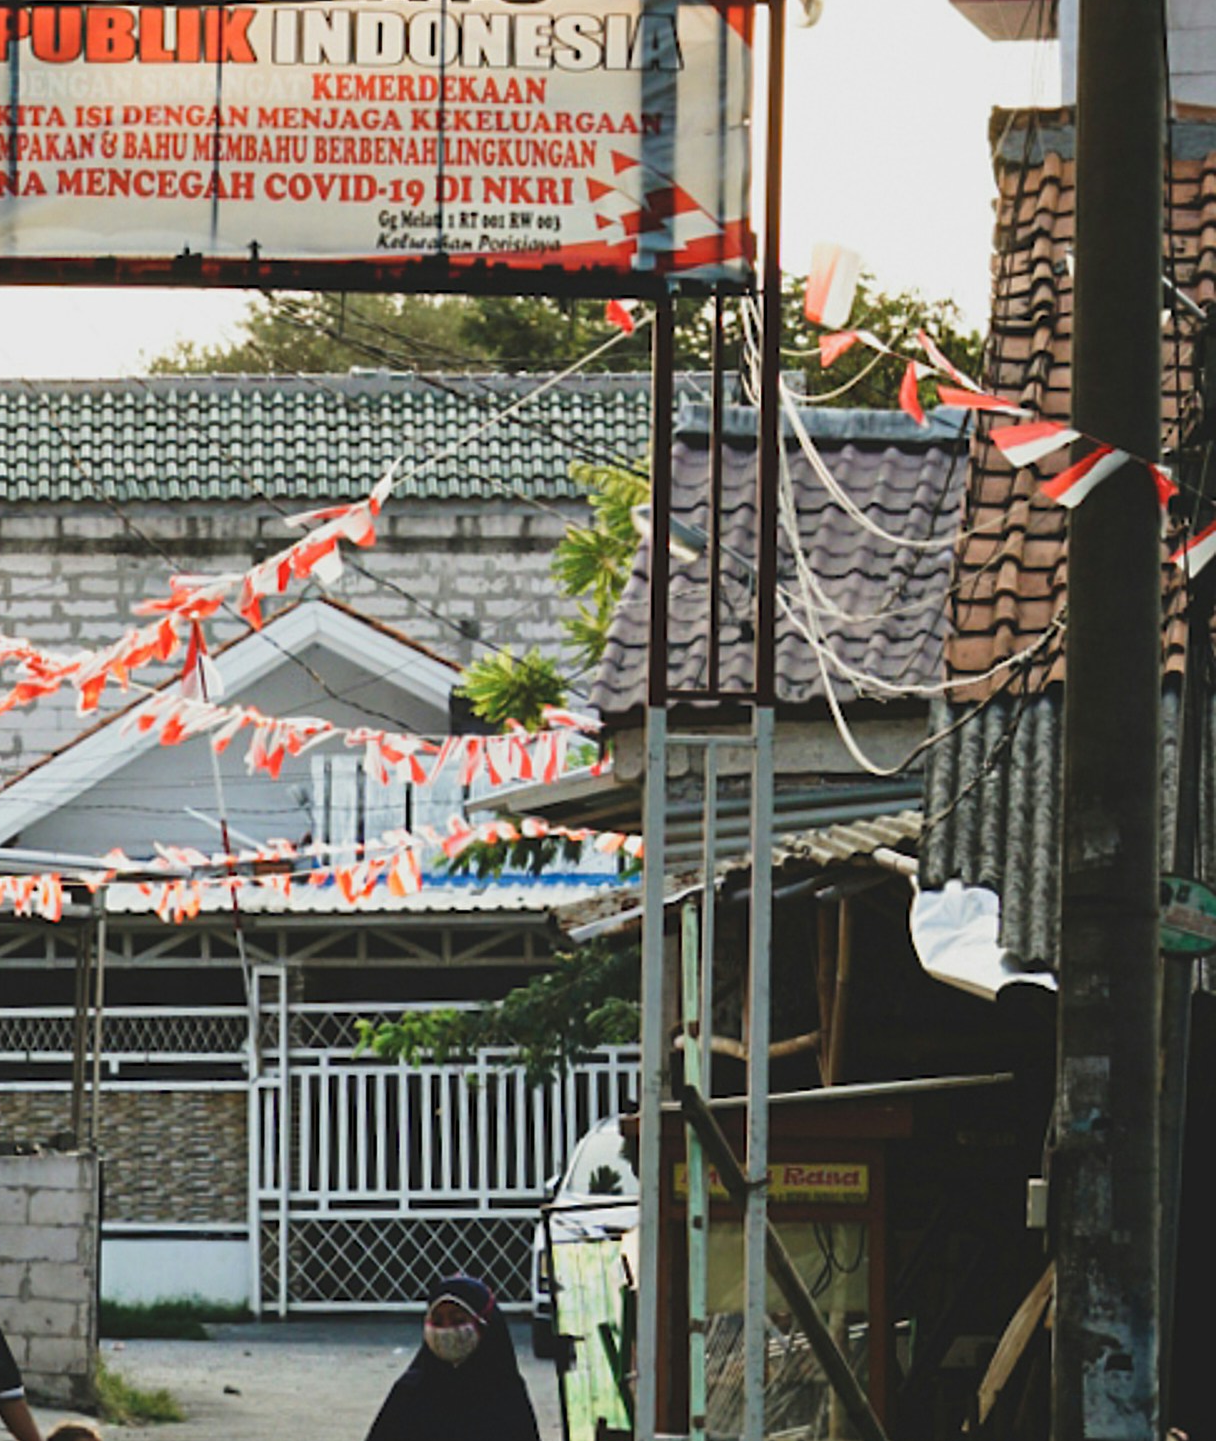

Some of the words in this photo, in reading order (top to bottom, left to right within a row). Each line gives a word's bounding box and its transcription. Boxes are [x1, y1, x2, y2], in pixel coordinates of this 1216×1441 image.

[271, 8, 684, 71] INDONESIA
[312, 73, 547, 104] KEMERDEKAAN
[75, 106, 114, 128] ISI
[122, 106, 249, 129] DENGAN
[257, 107, 401, 132] MENJAGA
[411, 109, 662, 136] KEKELUARGAAN
[100, 132, 117, 159] &
[123, 133, 186, 161] BAHU
[192, 135, 307, 165] MEMBAHU
[314, 136, 438, 167] BERBENAH
[444, 138, 597, 169] LINGKUNGAN
[57, 169, 256, 200] MENCEGAH
[264, 172, 425, 208] COVID-19
[435, 175, 472, 203] DI
[482, 177, 574, 205] NKRI
[401, 211, 442, 229] Melat
[459, 212, 478, 229] RT
[509, 211, 533, 230] RW
